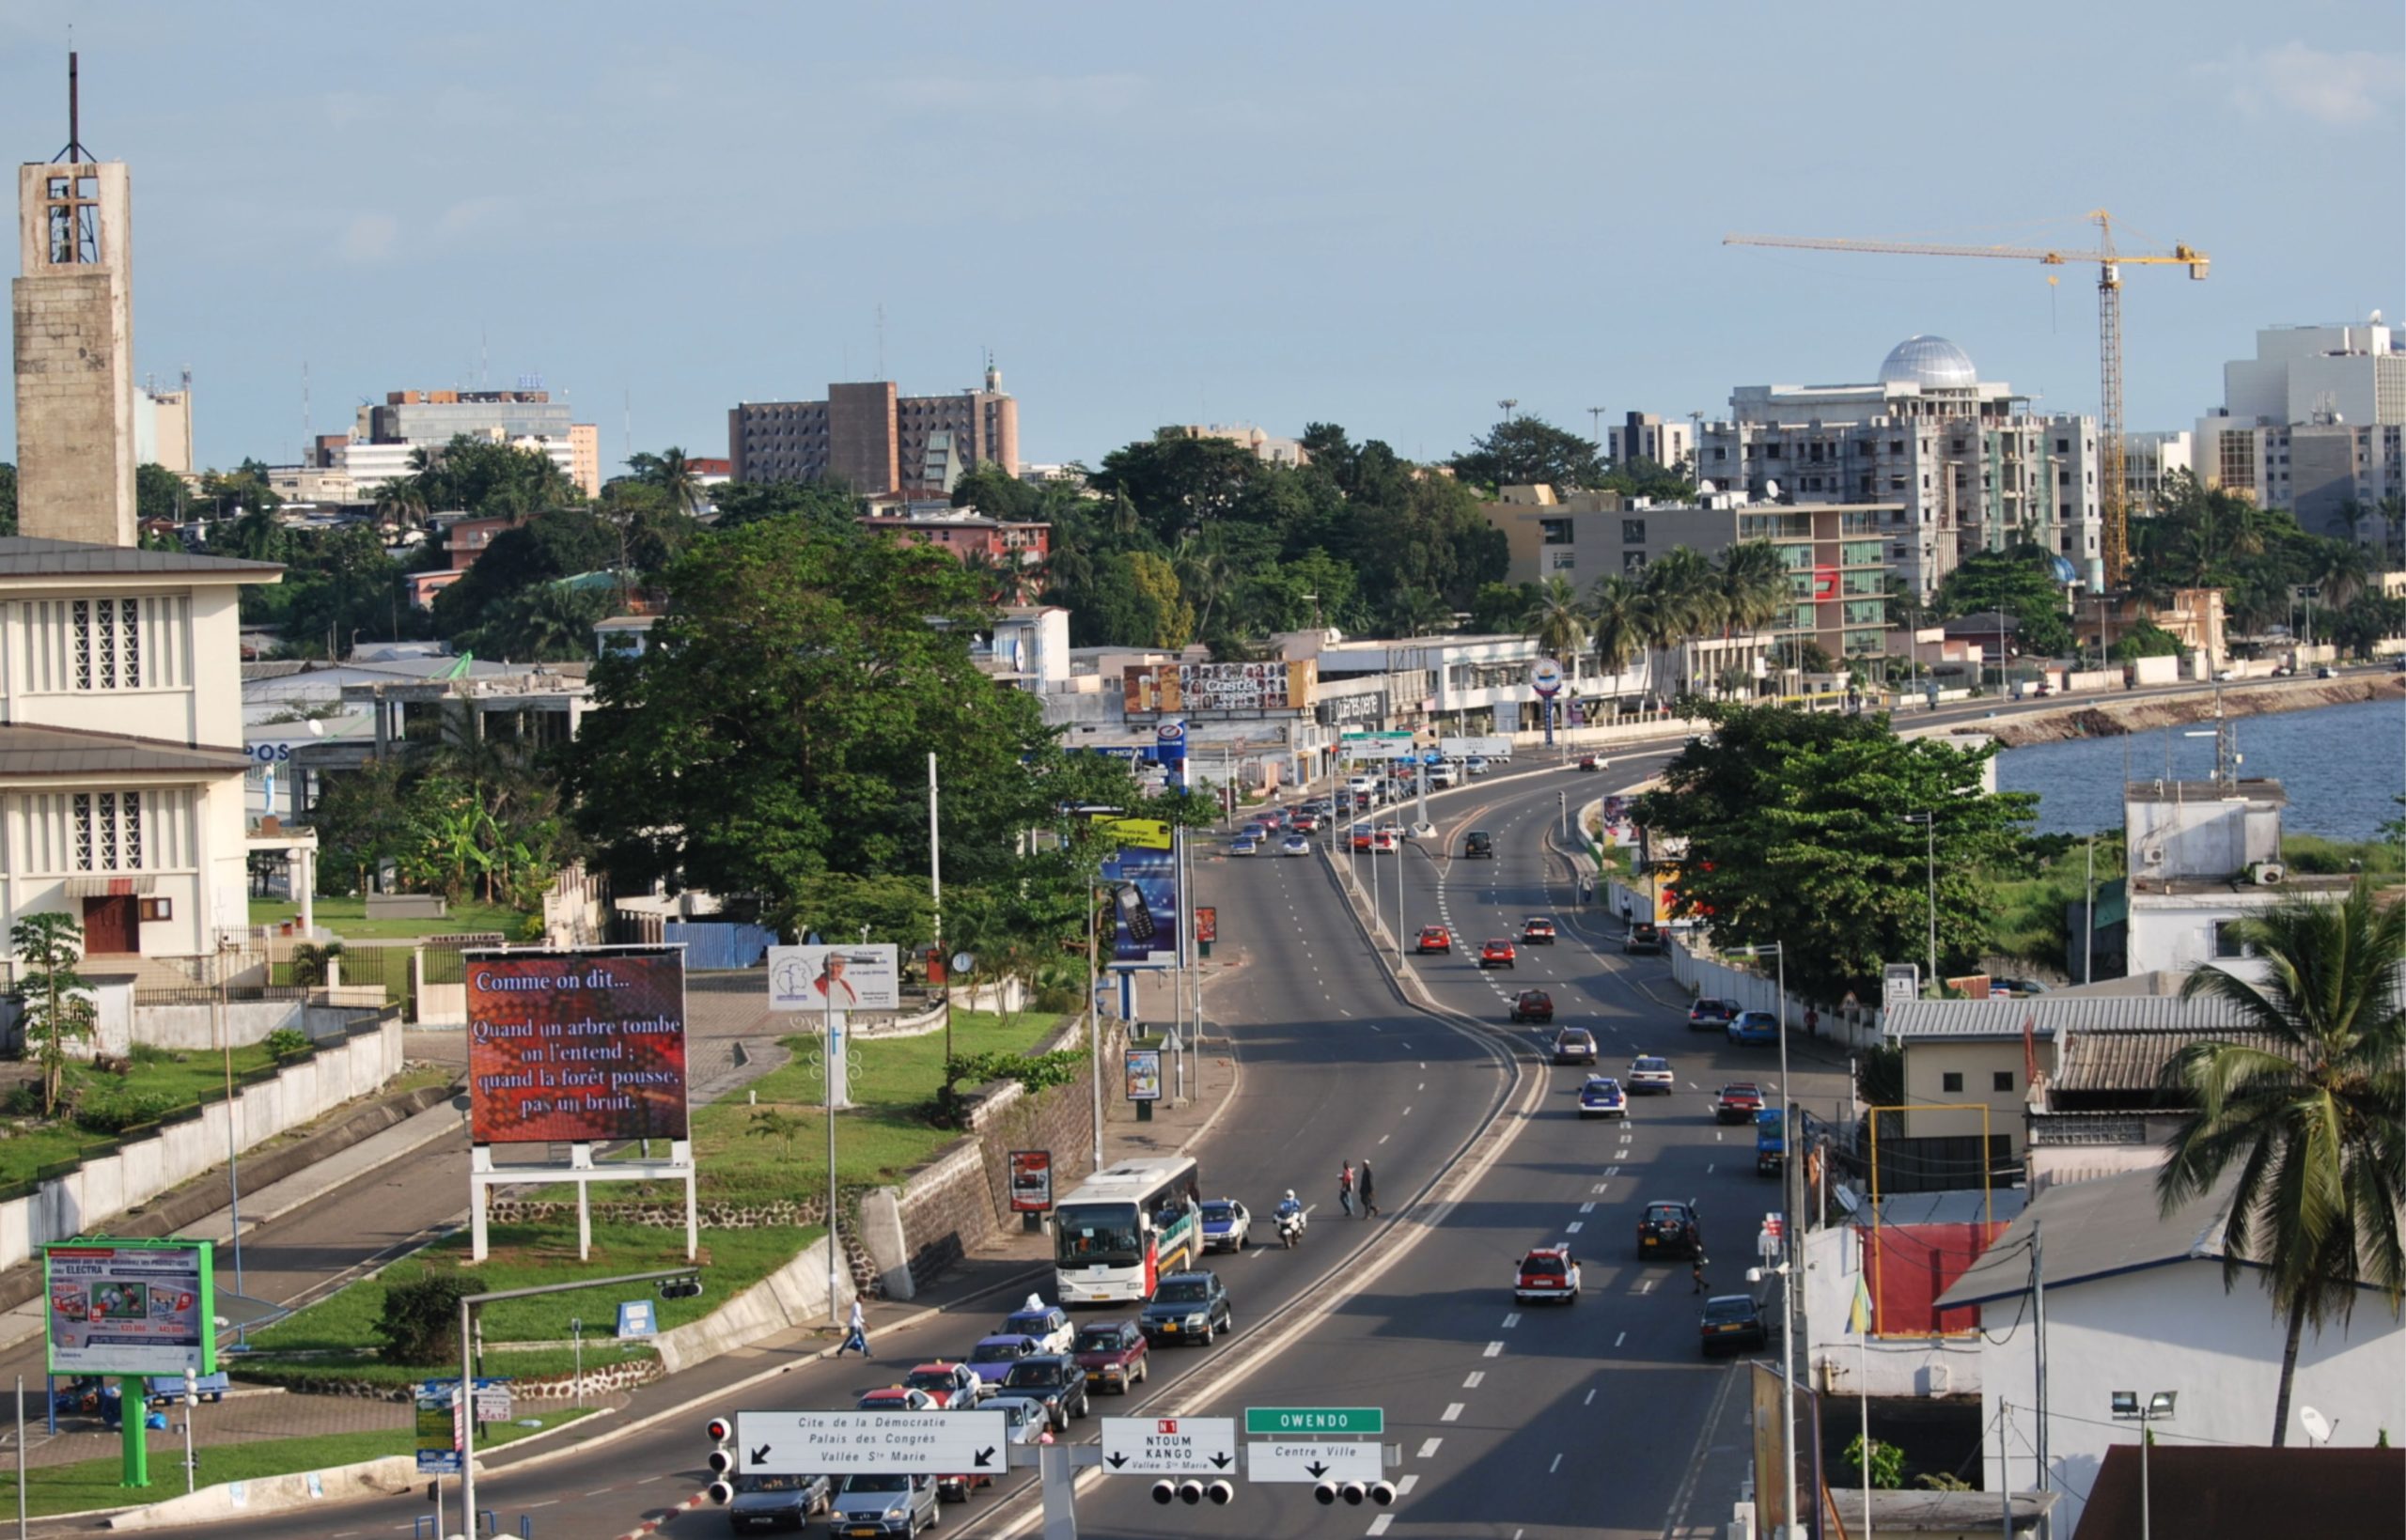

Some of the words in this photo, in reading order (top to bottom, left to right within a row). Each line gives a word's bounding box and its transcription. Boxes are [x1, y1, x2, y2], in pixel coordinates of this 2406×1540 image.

[477, 971, 551, 991] Comme
[556, 975, 580, 989] on
[586, 969, 630, 988] dit...
[473, 1018, 533, 1045] Quand
[539, 1022, 562, 1037] un
[568, 1017, 616, 1035] arbre
[622, 1014, 680, 1034] tombe
[521, 1048, 543, 1063] on
[550, 1041, 623, 1062] l'entend
[477, 1068, 533, 1095] quand
[539, 1068, 555, 1087] la
[561, 1067, 605, 1086] forêt
[612, 1070, 680, 1092] pousse,
[521, 1097, 552, 1118] pas
[556, 1098, 580, 1112] un
[586, 1092, 636, 1111] bruit.
[66, 1266, 102, 1275] ELECTRA
[833, 1417, 848, 1427] de
[856, 1418, 867, 1427] la
[875, 1417, 946, 1427] Démocratie
[1280, 1414, 1349, 1427] OWENDO
[809, 1434, 848, 1443] Palais
[856, 1434, 876, 1443] des
[1147, 1436, 1192, 1446] NTOUM
[1146, 1449, 1192, 1459] KANGO
[1275, 1446, 1317, 1457] Centre
[1326, 1446, 1356, 1457] Ville
[821, 1452, 860, 1462] Vallée
[891, 1452, 927, 1462] Marie
[1132, 1461, 1161, 1470] Vallée
[1182, 1461, 1209, 1470] Marie
